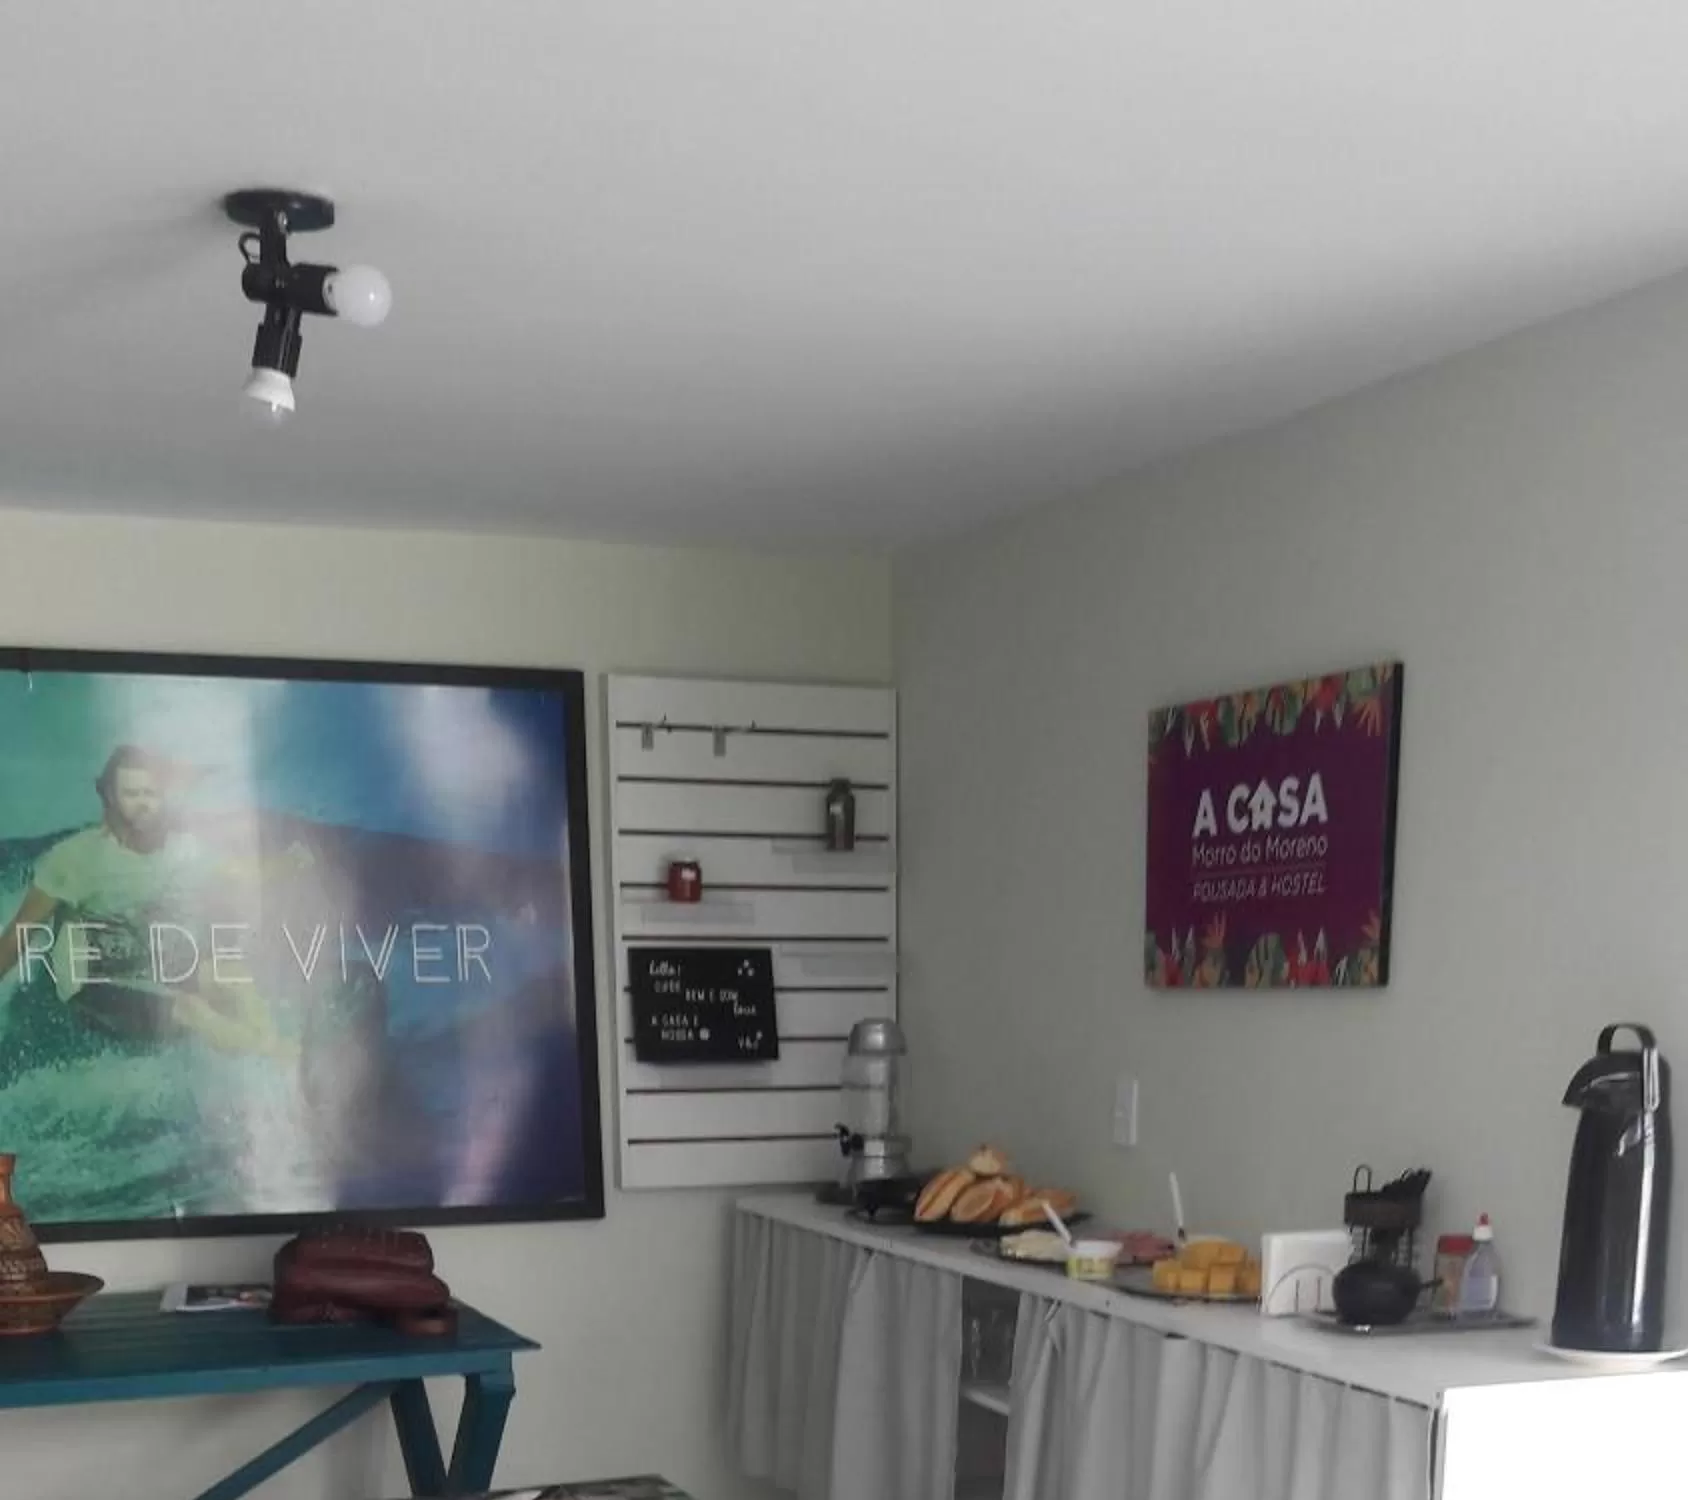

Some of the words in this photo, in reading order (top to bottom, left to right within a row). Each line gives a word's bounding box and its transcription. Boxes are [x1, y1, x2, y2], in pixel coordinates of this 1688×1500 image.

[1192, 787, 1218, 838] A
[1226, 771, 1329, 834] CASA
[1192, 842, 1237, 868] Morro
[1240, 836, 1262, 864] do
[1265, 834, 1329, 862] Moreno
[1193, 877, 1257, 902] POUSADA
[1271, 871, 1326, 898] HOSTEL
[16, 923, 112, 985] RE
[149, 922, 254, 984] DE
[281, 921, 493, 984] VIVER
